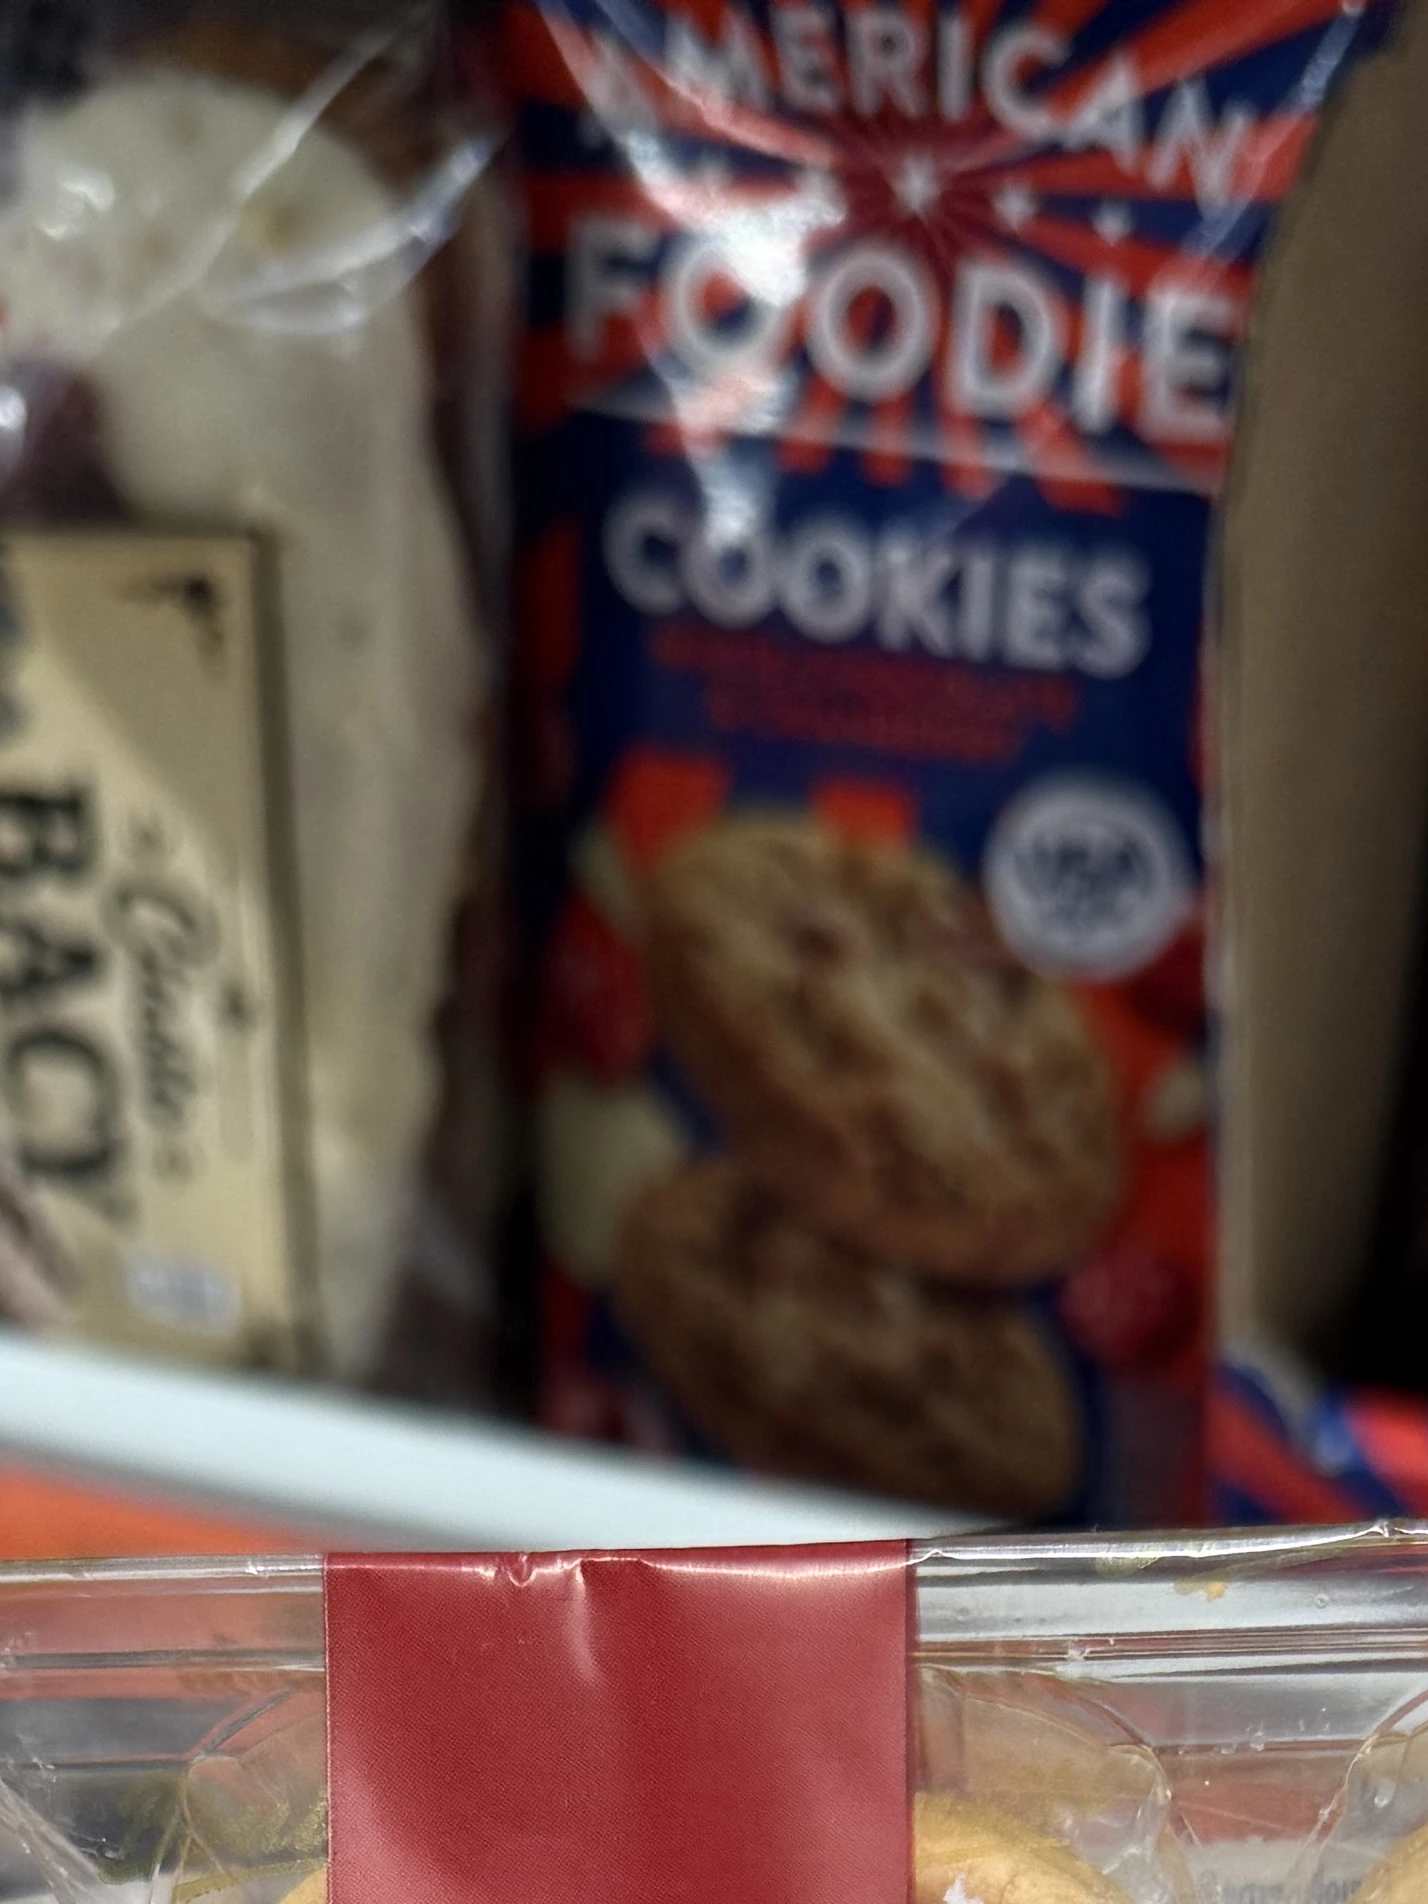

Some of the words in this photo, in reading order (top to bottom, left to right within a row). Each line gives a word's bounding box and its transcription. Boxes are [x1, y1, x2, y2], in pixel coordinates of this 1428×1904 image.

[577, 0, 1257, 205] AMERICAN
[570, 215, 1247, 442] FOODIE
[600, 485, 1152, 680] COOKIES
